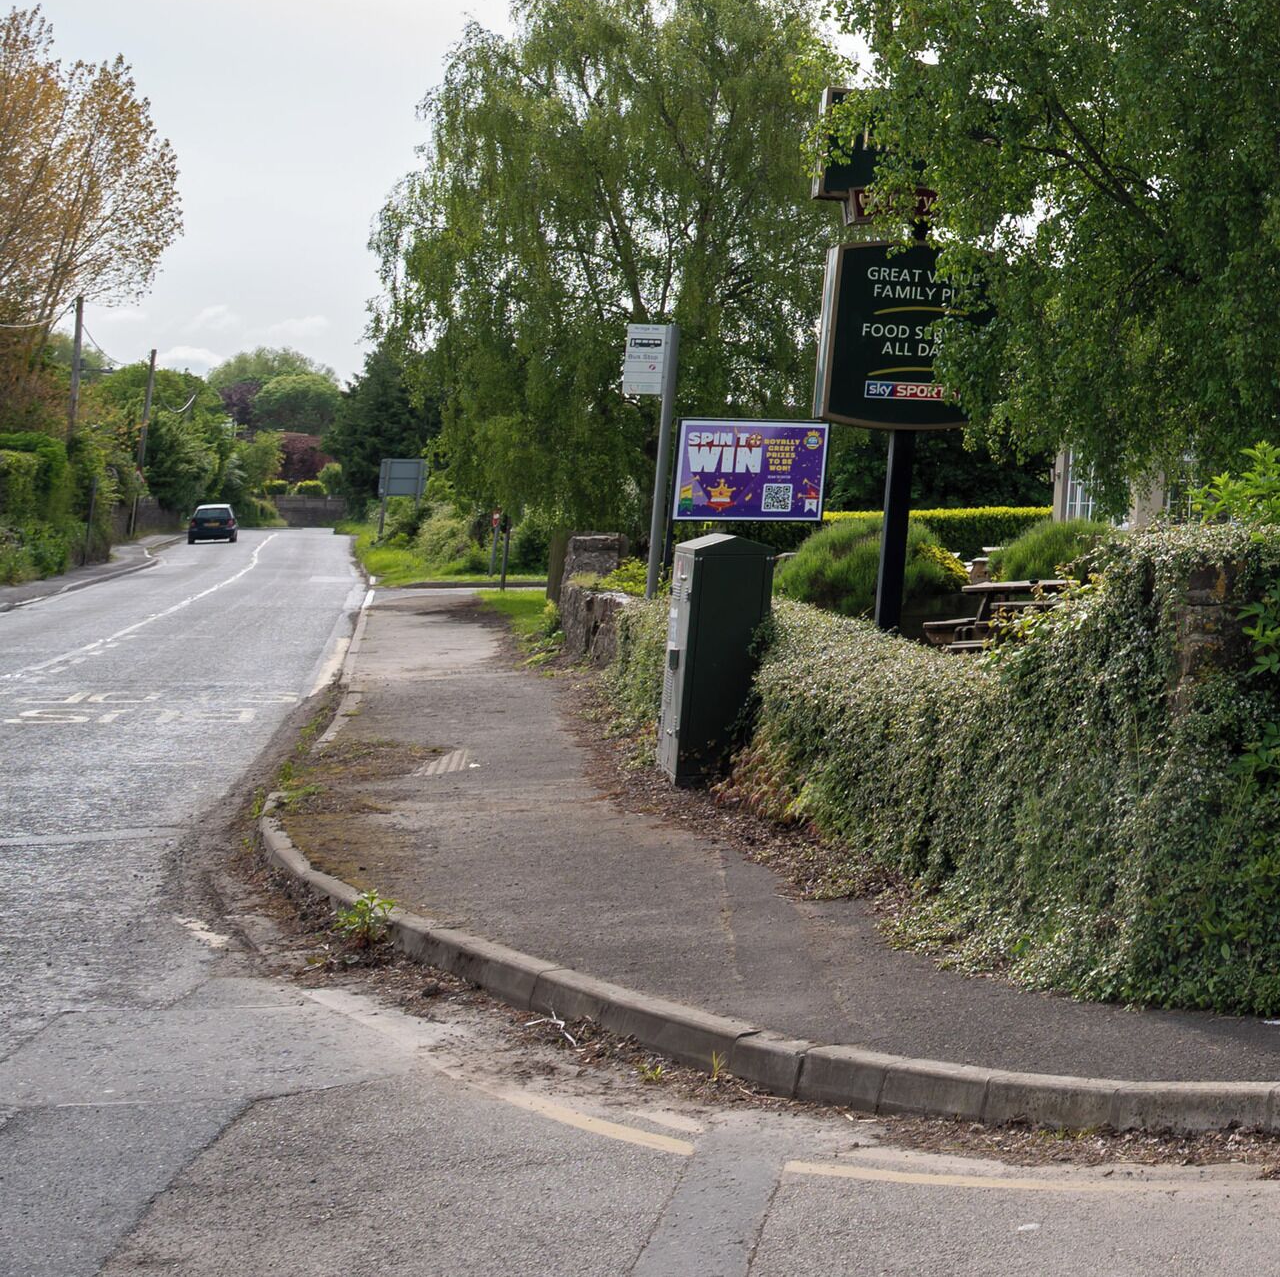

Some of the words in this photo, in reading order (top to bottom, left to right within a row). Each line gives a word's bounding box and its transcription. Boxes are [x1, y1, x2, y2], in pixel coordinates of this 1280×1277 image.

[867, 267, 922, 282] GREAT
[873, 284, 937, 300] FAMILY
[862, 323, 910, 338] FOOD
[882, 341, 912, 356] ALL
[918, 343, 944, 357] DA
[869, 383, 893, 397] sky
[688, 431, 733, 445] SPIN
[688, 446, 763, 473] WIN
